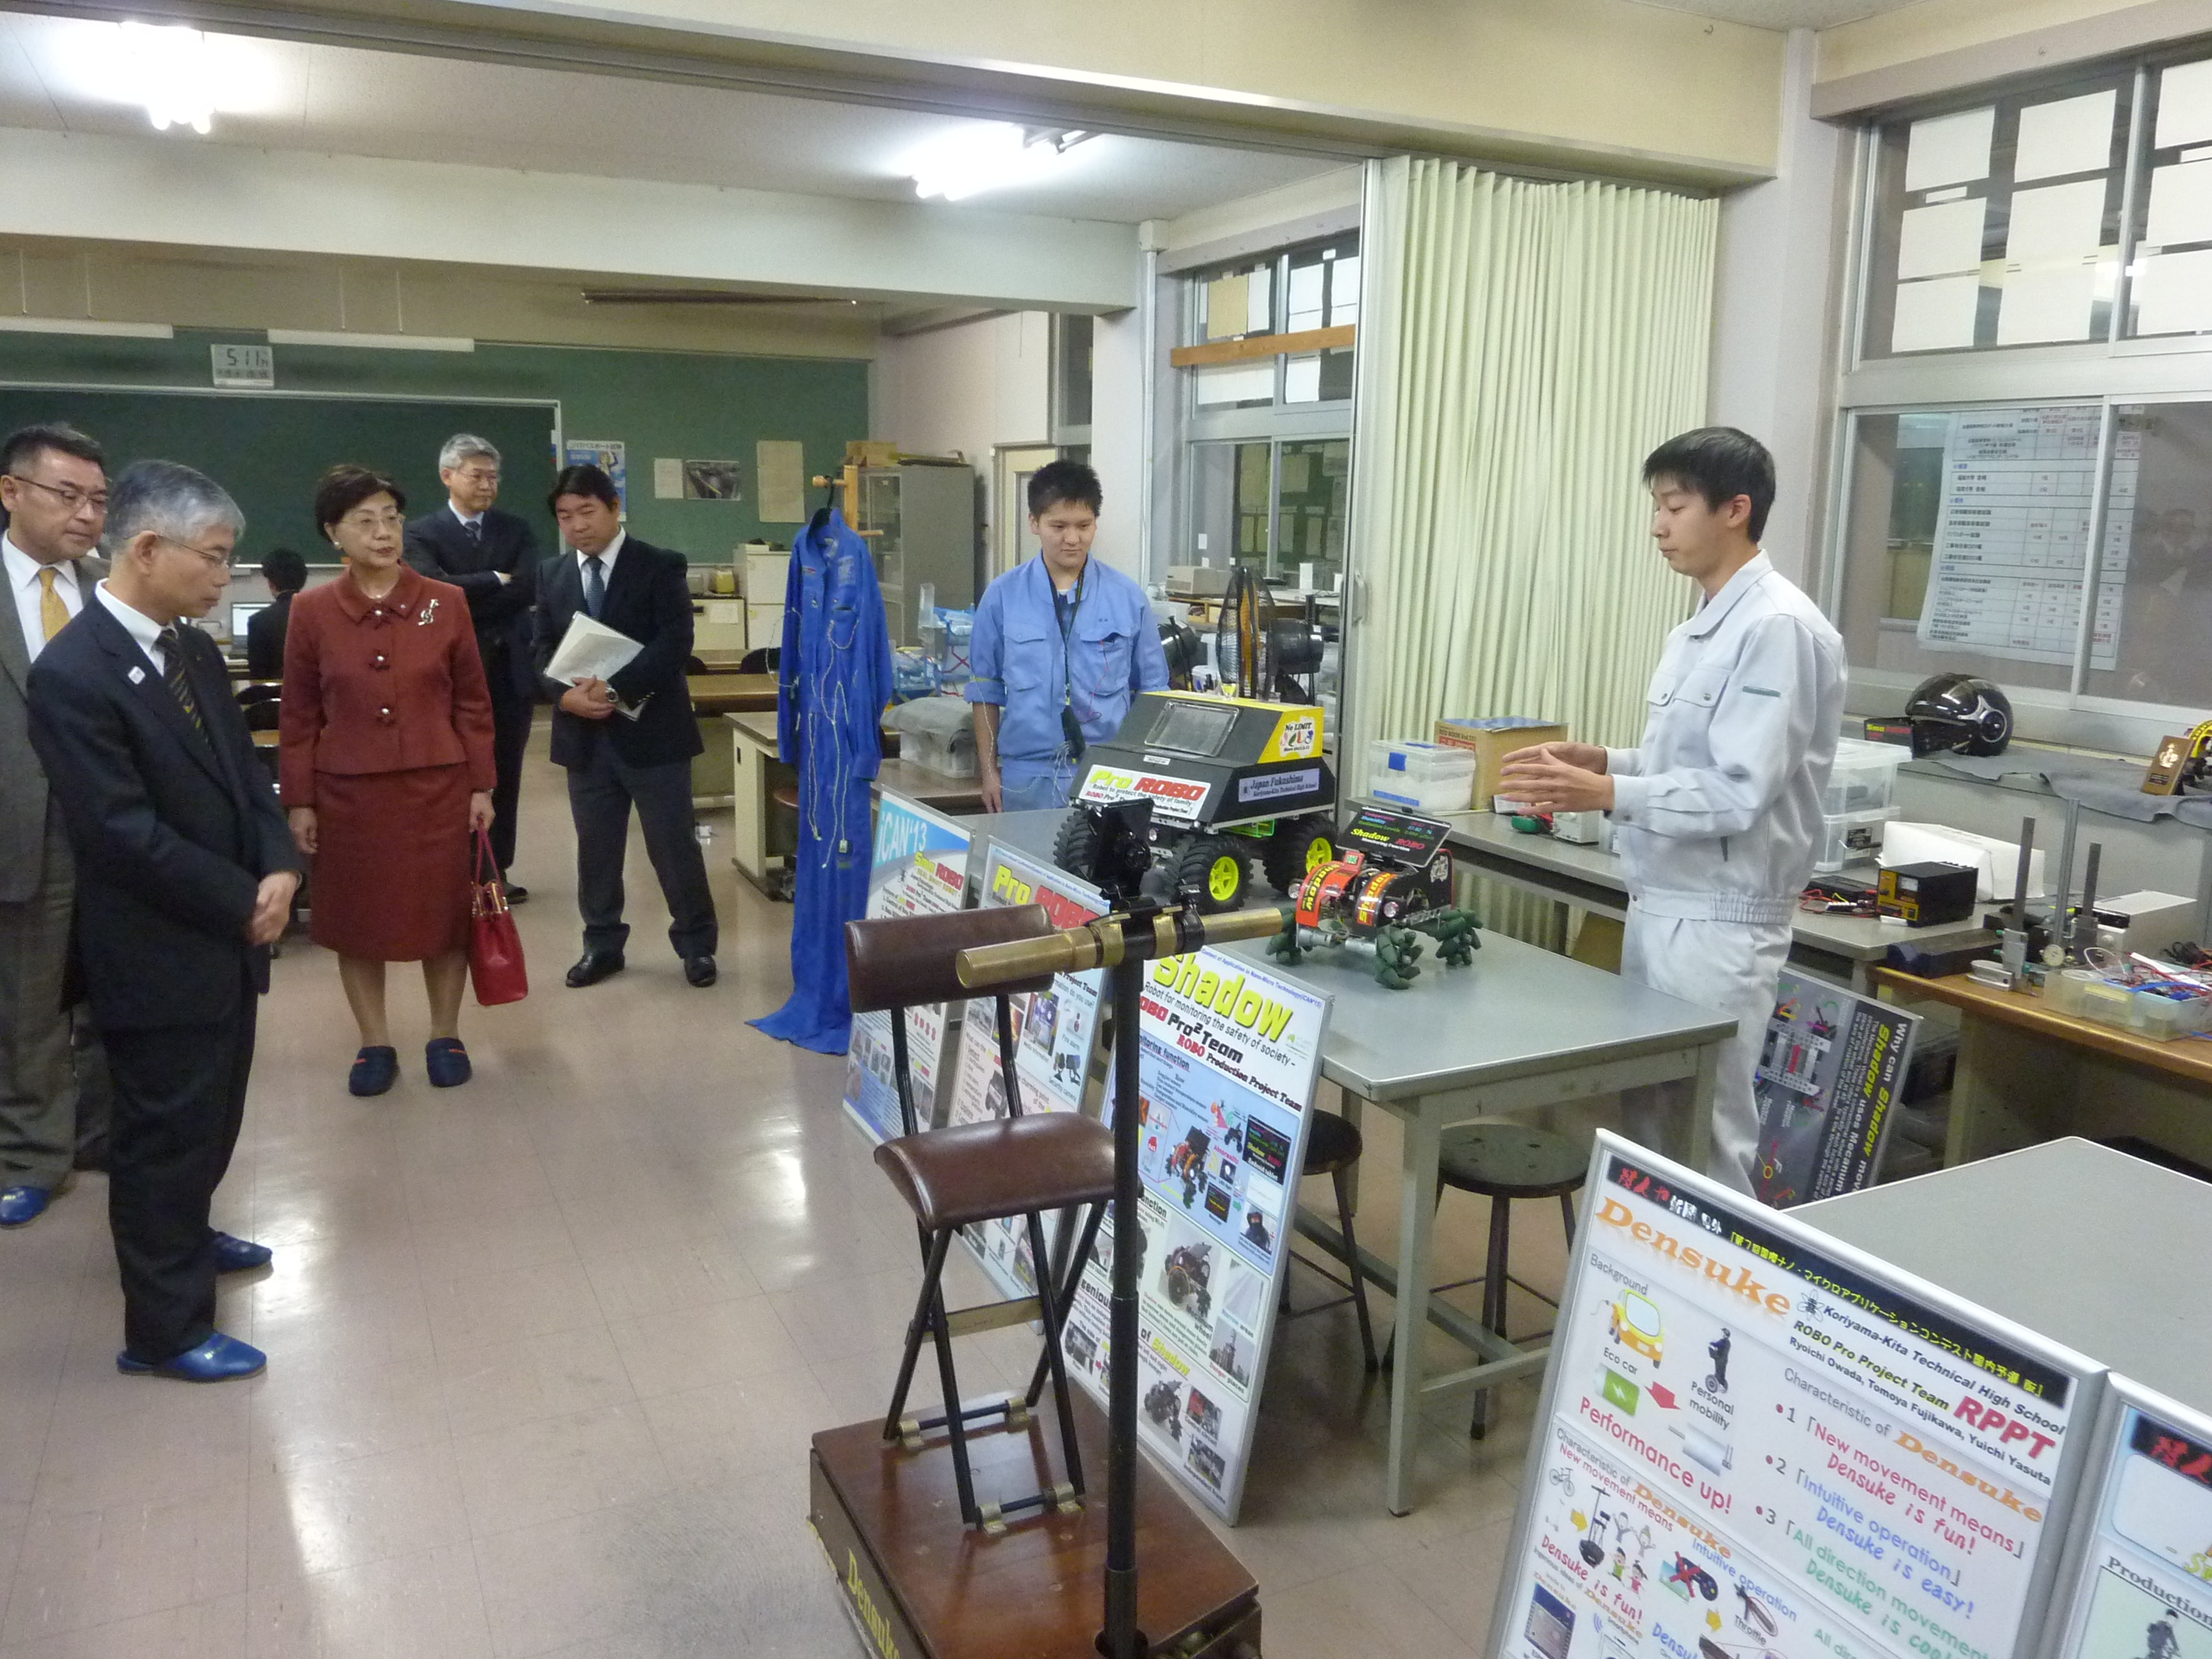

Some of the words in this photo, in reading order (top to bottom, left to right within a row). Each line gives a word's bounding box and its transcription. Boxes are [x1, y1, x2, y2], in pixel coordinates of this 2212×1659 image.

[1090, 770, 1133, 789] Pro
[1134, 778, 1206, 801] ROBO
[1092, 784, 1109, 792] Robot
[1148, 793, 1166, 803] safety
[1250, 779, 1269, 790] Japan
[1270, 774, 1304, 786] Fukushima
[1351, 829, 1389, 842] Shadow
[993, 864, 1032, 905] Pro
[1140, 996, 1169, 1022] OBO
[1202, 1031, 1243, 1065] Team
[1144, 982, 1164, 1000] Robot
[1165, 990, 1174, 1003] for
[1175, 998, 1211, 1026] monitoring
[1213, 1017, 1224, 1032] the
[1225, 1026, 1249, 1049] safety
[1250, 1037, 1260, 1050] of
[1261, 1044, 1290, 1066] society
[1153, 951, 1294, 1042] Shadow
[1160, 1047, 1192, 1071] function
[1861, 1022, 1891, 1099] Shadow
[1882, 1055, 1897, 1082] can
[1888, 1020, 1908, 1053] Why
[1177, 1034, 1206, 1058] ROBO
[1206, 1052, 1249, 1083] Production
[1249, 1076, 1281, 1101] Project
[1280, 1092, 1303, 1113] Team
[1852, 1098, 1867, 1129] uses
[1860, 1085, 1891, 1159] Shadow
[1834, 1130, 1859, 1193] Mecanum
[1591, 1253, 1649, 1295] Background
[1596, 1196, 1790, 1315] Densuke
[1141, 1327, 1152, 1343] of
[1152, 1337, 1191, 1376] Shadow
[1603, 1346, 1620, 1365] Eco
[1622, 1359, 1638, 1376] car
[1822, 1306, 1909, 1357] Koriyama-Kita
[1912, 1351, 1976, 1390] Technical
[1978, 1384, 2011, 1408] High
[2014, 1404, 2065, 1435] School
[1689, 1398, 1731, 1431] mobility
[1690, 1381, 1734, 1415] Personal
[1789, 1337, 1826, 1363] Ryoichi
[1827, 1357, 1865, 1386] Owada,
[1867, 1379, 1908, 1409] Tomoya
[1910, 1402, 1965, 1441] Fujikawa,
[1968, 1433, 2005, 1461] Yuichi
[2008, 1454, 2051, 1486] Yasuta
[1794, 1320, 1832, 1346] ROBO
[1833, 1341, 1855, 1360] Pro
[1858, 1355, 1909, 1389] Project
[1910, 1382, 1950, 1410] Team
[1954, 1395, 2056, 1460] RPPT
[1580, 1395, 1694, 1488] Performance
[1700, 1482, 1732, 1515] up!
[1776, 1457, 1787, 1475] 2
[1784, 1368, 1871, 1427] Characteristic
[1875, 1422, 1892, 1437] of
[1894, 1429, 2043, 1522] Densuke
[1787, 1408, 1796, 1423] 1
[1854, 1448, 1948, 1511] movement
[1556, 1427, 1618, 1478] Characteristic
[1620, 1474, 1631, 1488] of
[1632, 1482, 1732, 1560] Densuke
[1559, 1443, 1581, 1465] New
[1582, 1459, 1637, 1505] movement
[1637, 1499, 1675, 1533] means
[1827, 1452, 1897, 1506] Densuke
[1904, 1503, 1925, 1524] is
[1933, 1518, 1976, 1555] fun!
[1541, 1535, 1589, 1581] Densuke
[1594, 1580, 1609, 1598] is
[1614, 1592, 1643, 1625] fun!
[1692, 1537, 1737, 1578] Intuitive
[1738, 1573, 1798, 1623] operation
[1765, 1509, 1777, 1526] 3
[1816, 1545, 1886, 1600] direction
[1815, 1505, 1885, 1560] Densuke
[1893, 1559, 1913, 1580] is
[1921, 1577, 1975, 1620] easy!
[1584, 1586, 1643, 1638] Densuke
[1734, 1614, 1767, 1646] Throttle
[1806, 1559, 1872, 1616] Densuke
[1881, 1613, 1901, 1636] is
[1815, 1628, 1832, 1649] All
